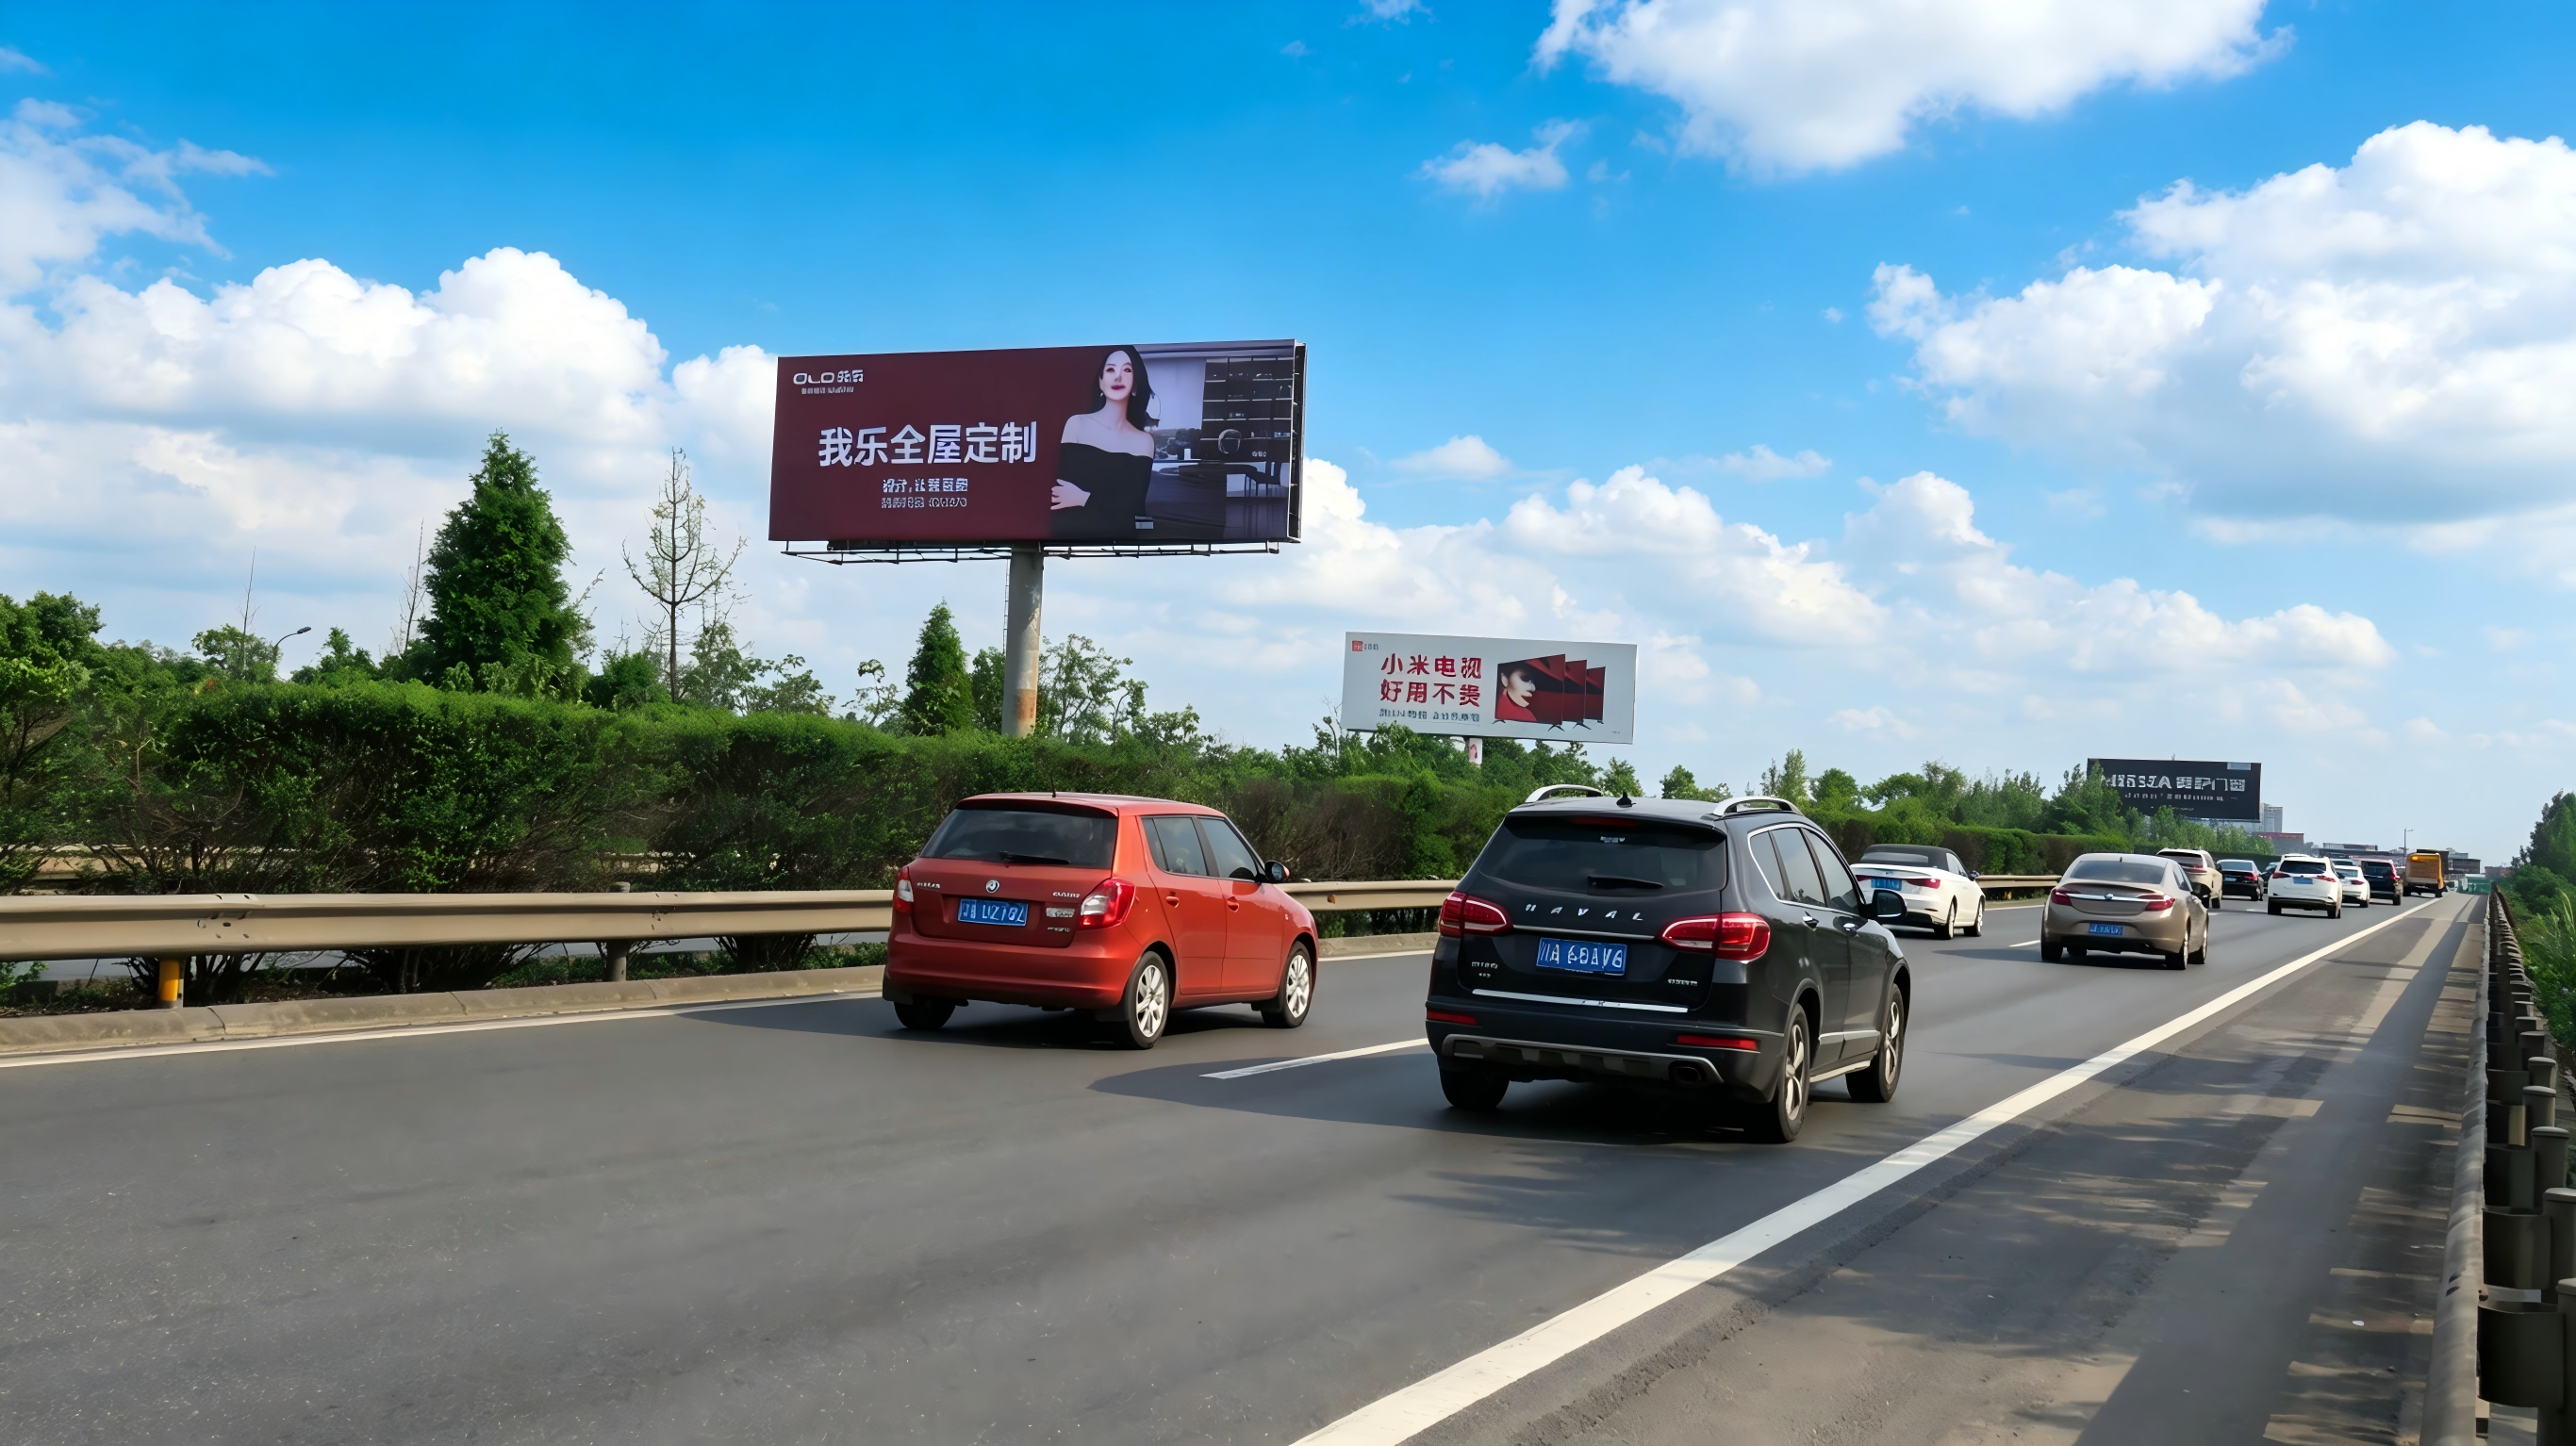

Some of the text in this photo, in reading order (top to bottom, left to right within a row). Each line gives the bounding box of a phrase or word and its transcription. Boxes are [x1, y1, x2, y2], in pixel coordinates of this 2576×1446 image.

[818, 420, 1037, 468] 我乐全屋定制
